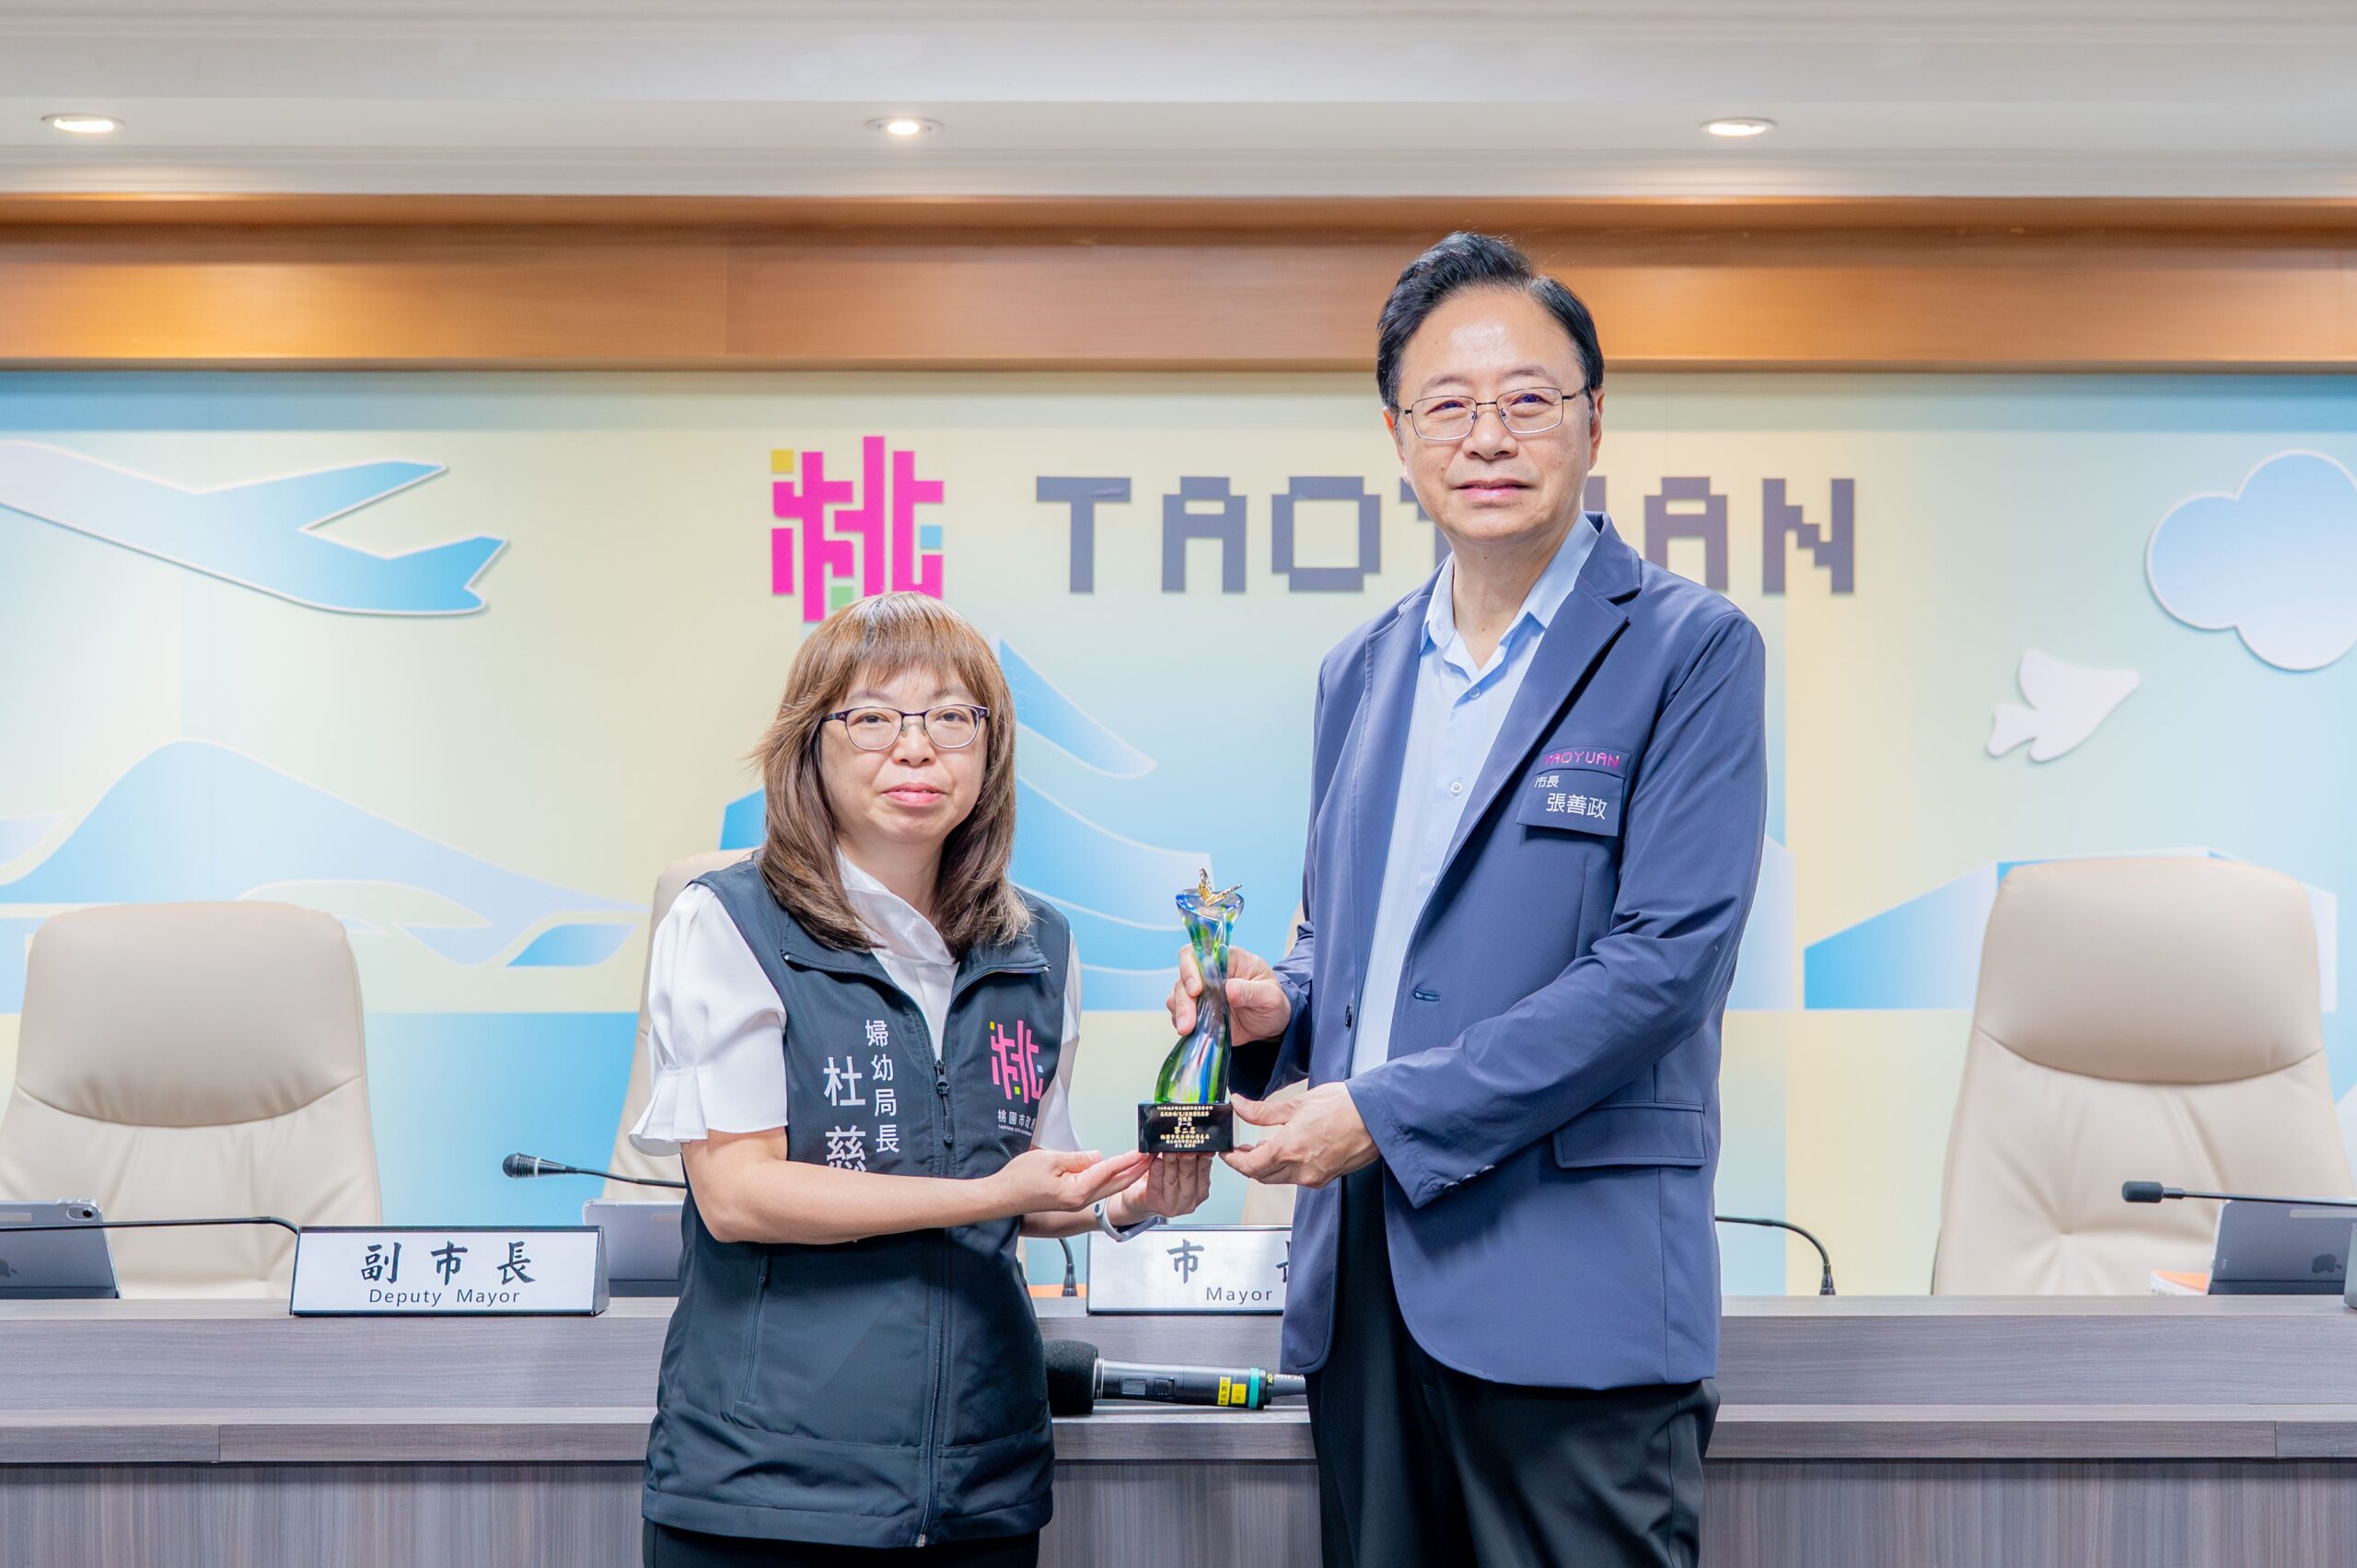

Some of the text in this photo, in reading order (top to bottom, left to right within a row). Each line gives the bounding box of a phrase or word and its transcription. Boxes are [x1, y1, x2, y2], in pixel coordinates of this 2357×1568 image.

[1037, 475, 1855, 595] TAOAN
[1544, 750, 1620, 768] TAOYUAN
[1534, 775, 1560, 788] 市長
[1546, 793, 1608, 819] 張善政
[865, 1019, 900, 1154] 婦幼局長
[360, 1240, 536, 1286] 副市長
[369, 1289, 521, 1307] Deputy Mayor
[1206, 1286, 1272, 1305] Mayor
